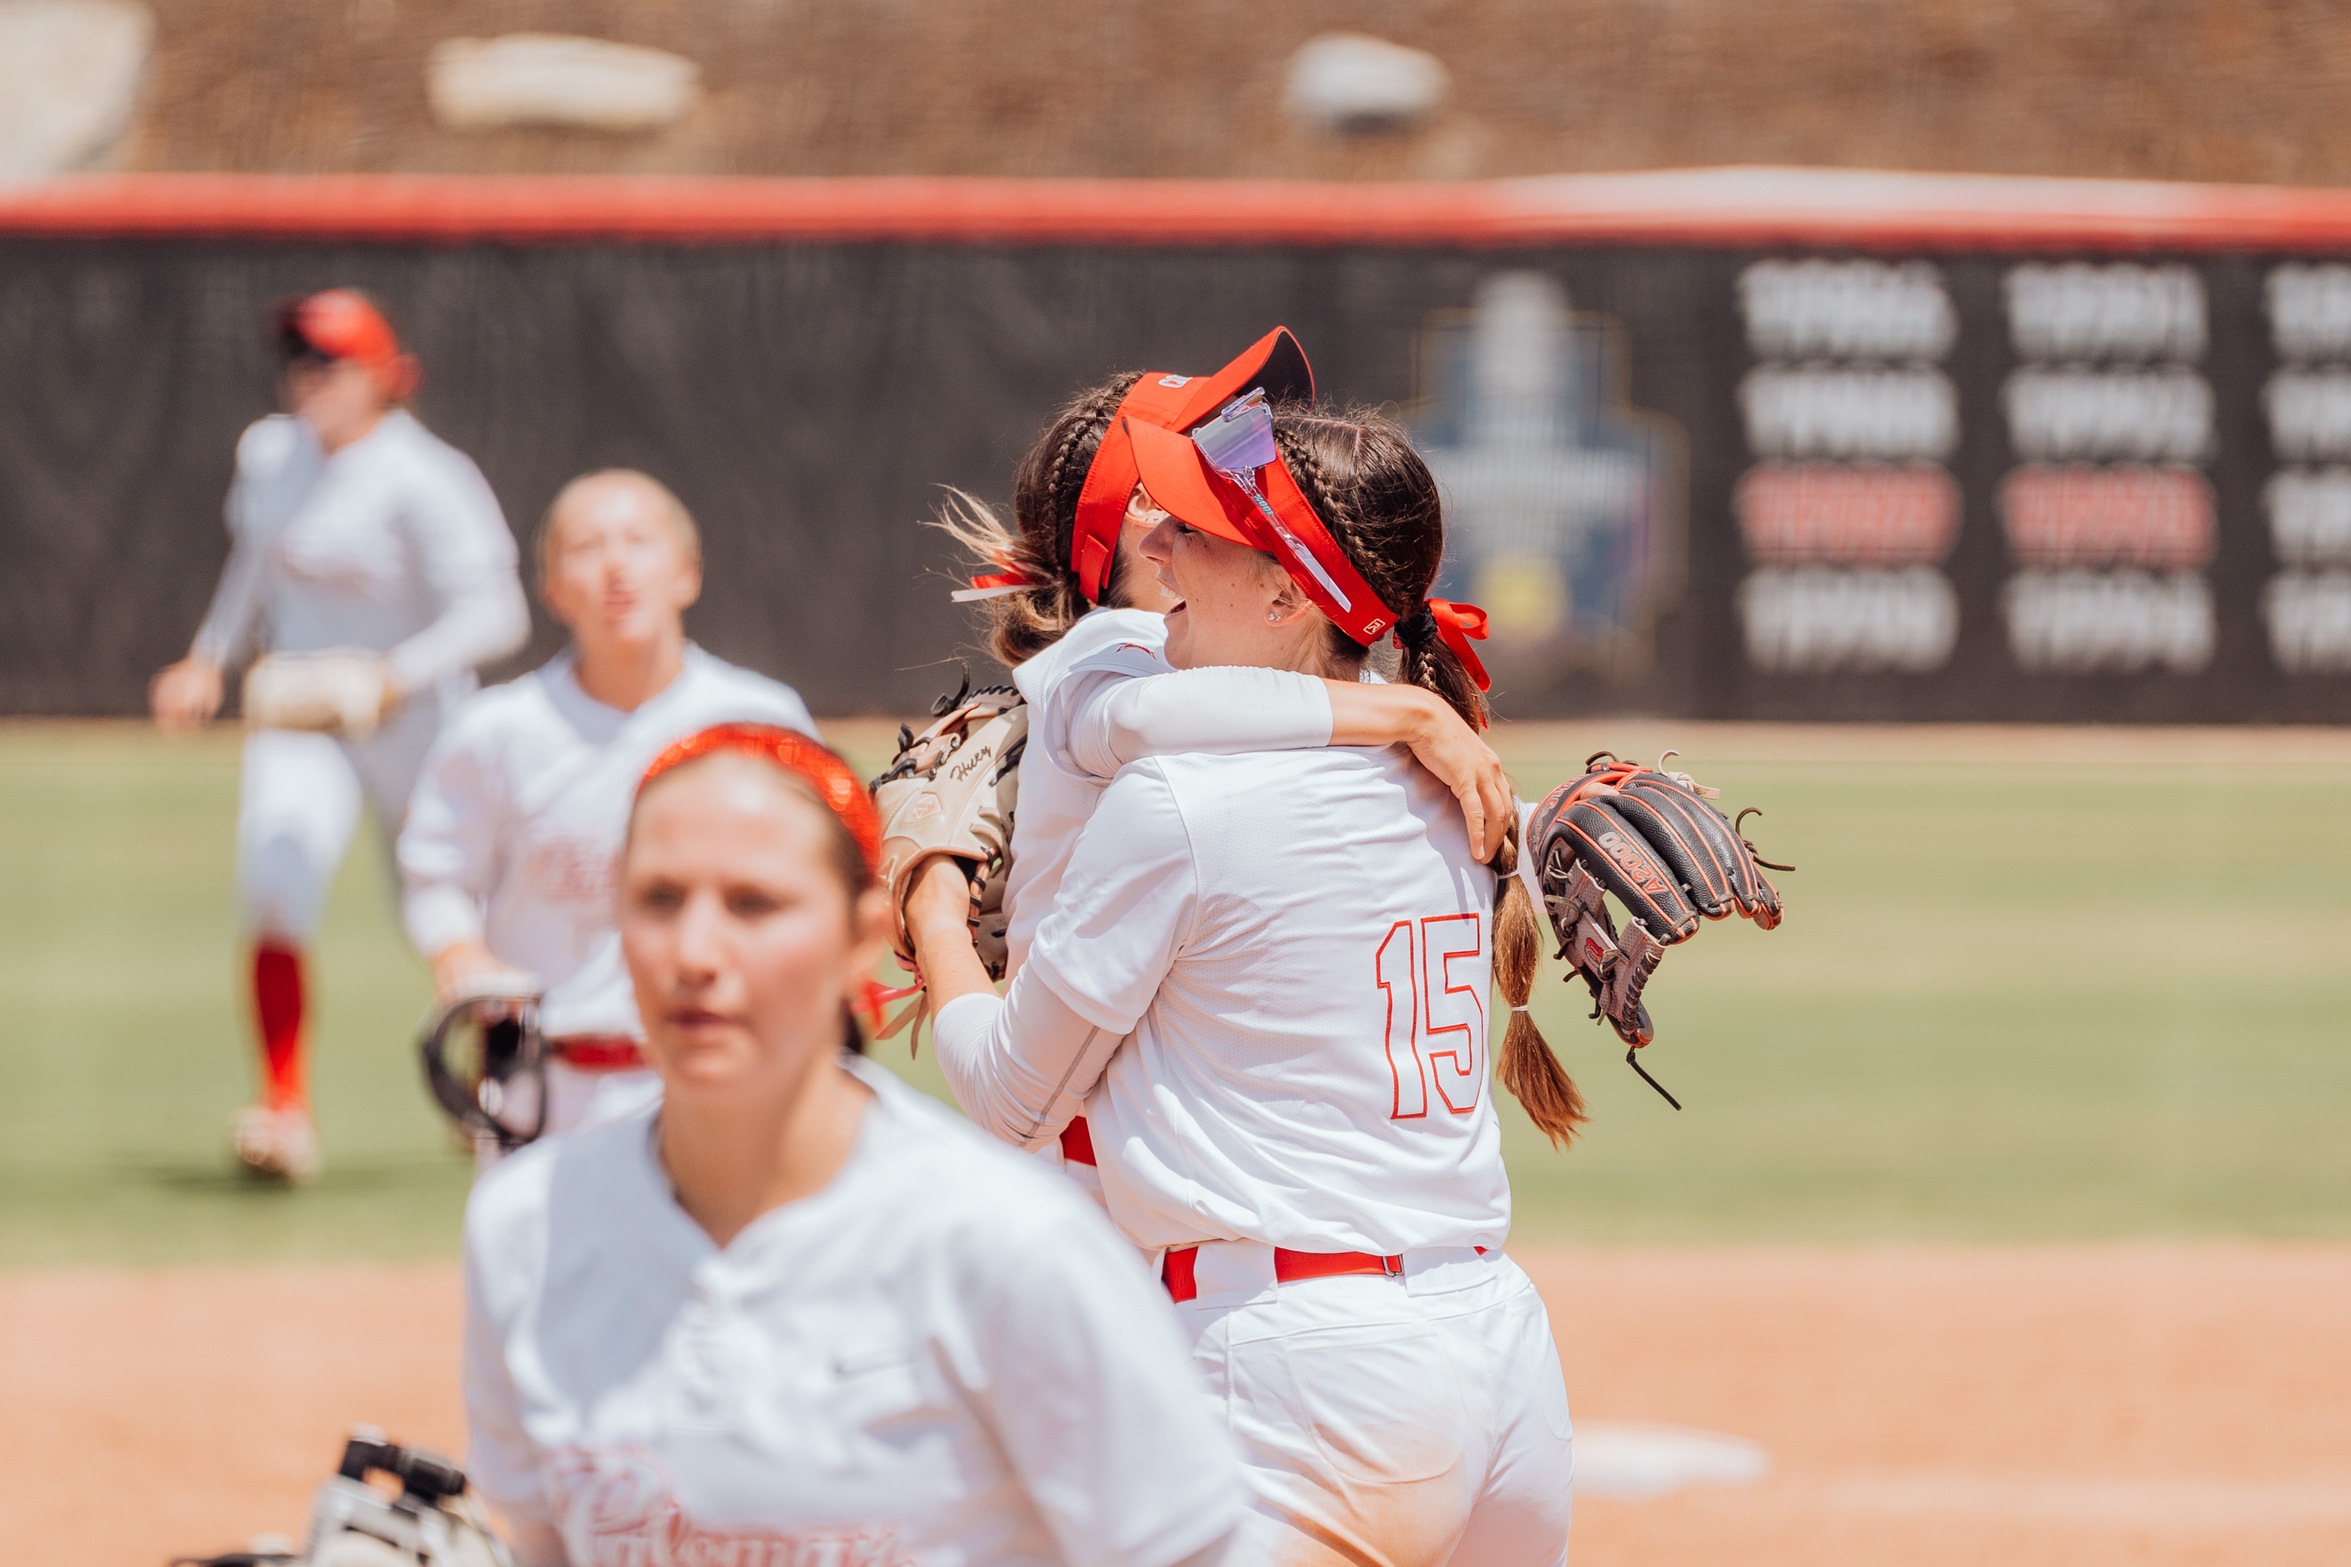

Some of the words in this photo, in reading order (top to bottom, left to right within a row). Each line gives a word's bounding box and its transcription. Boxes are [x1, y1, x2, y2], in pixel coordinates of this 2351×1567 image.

[1254, 493, 1274, 516] 100%
[1598, 831, 1669, 893] A2000
[1376, 912, 1484, 1120] 15
